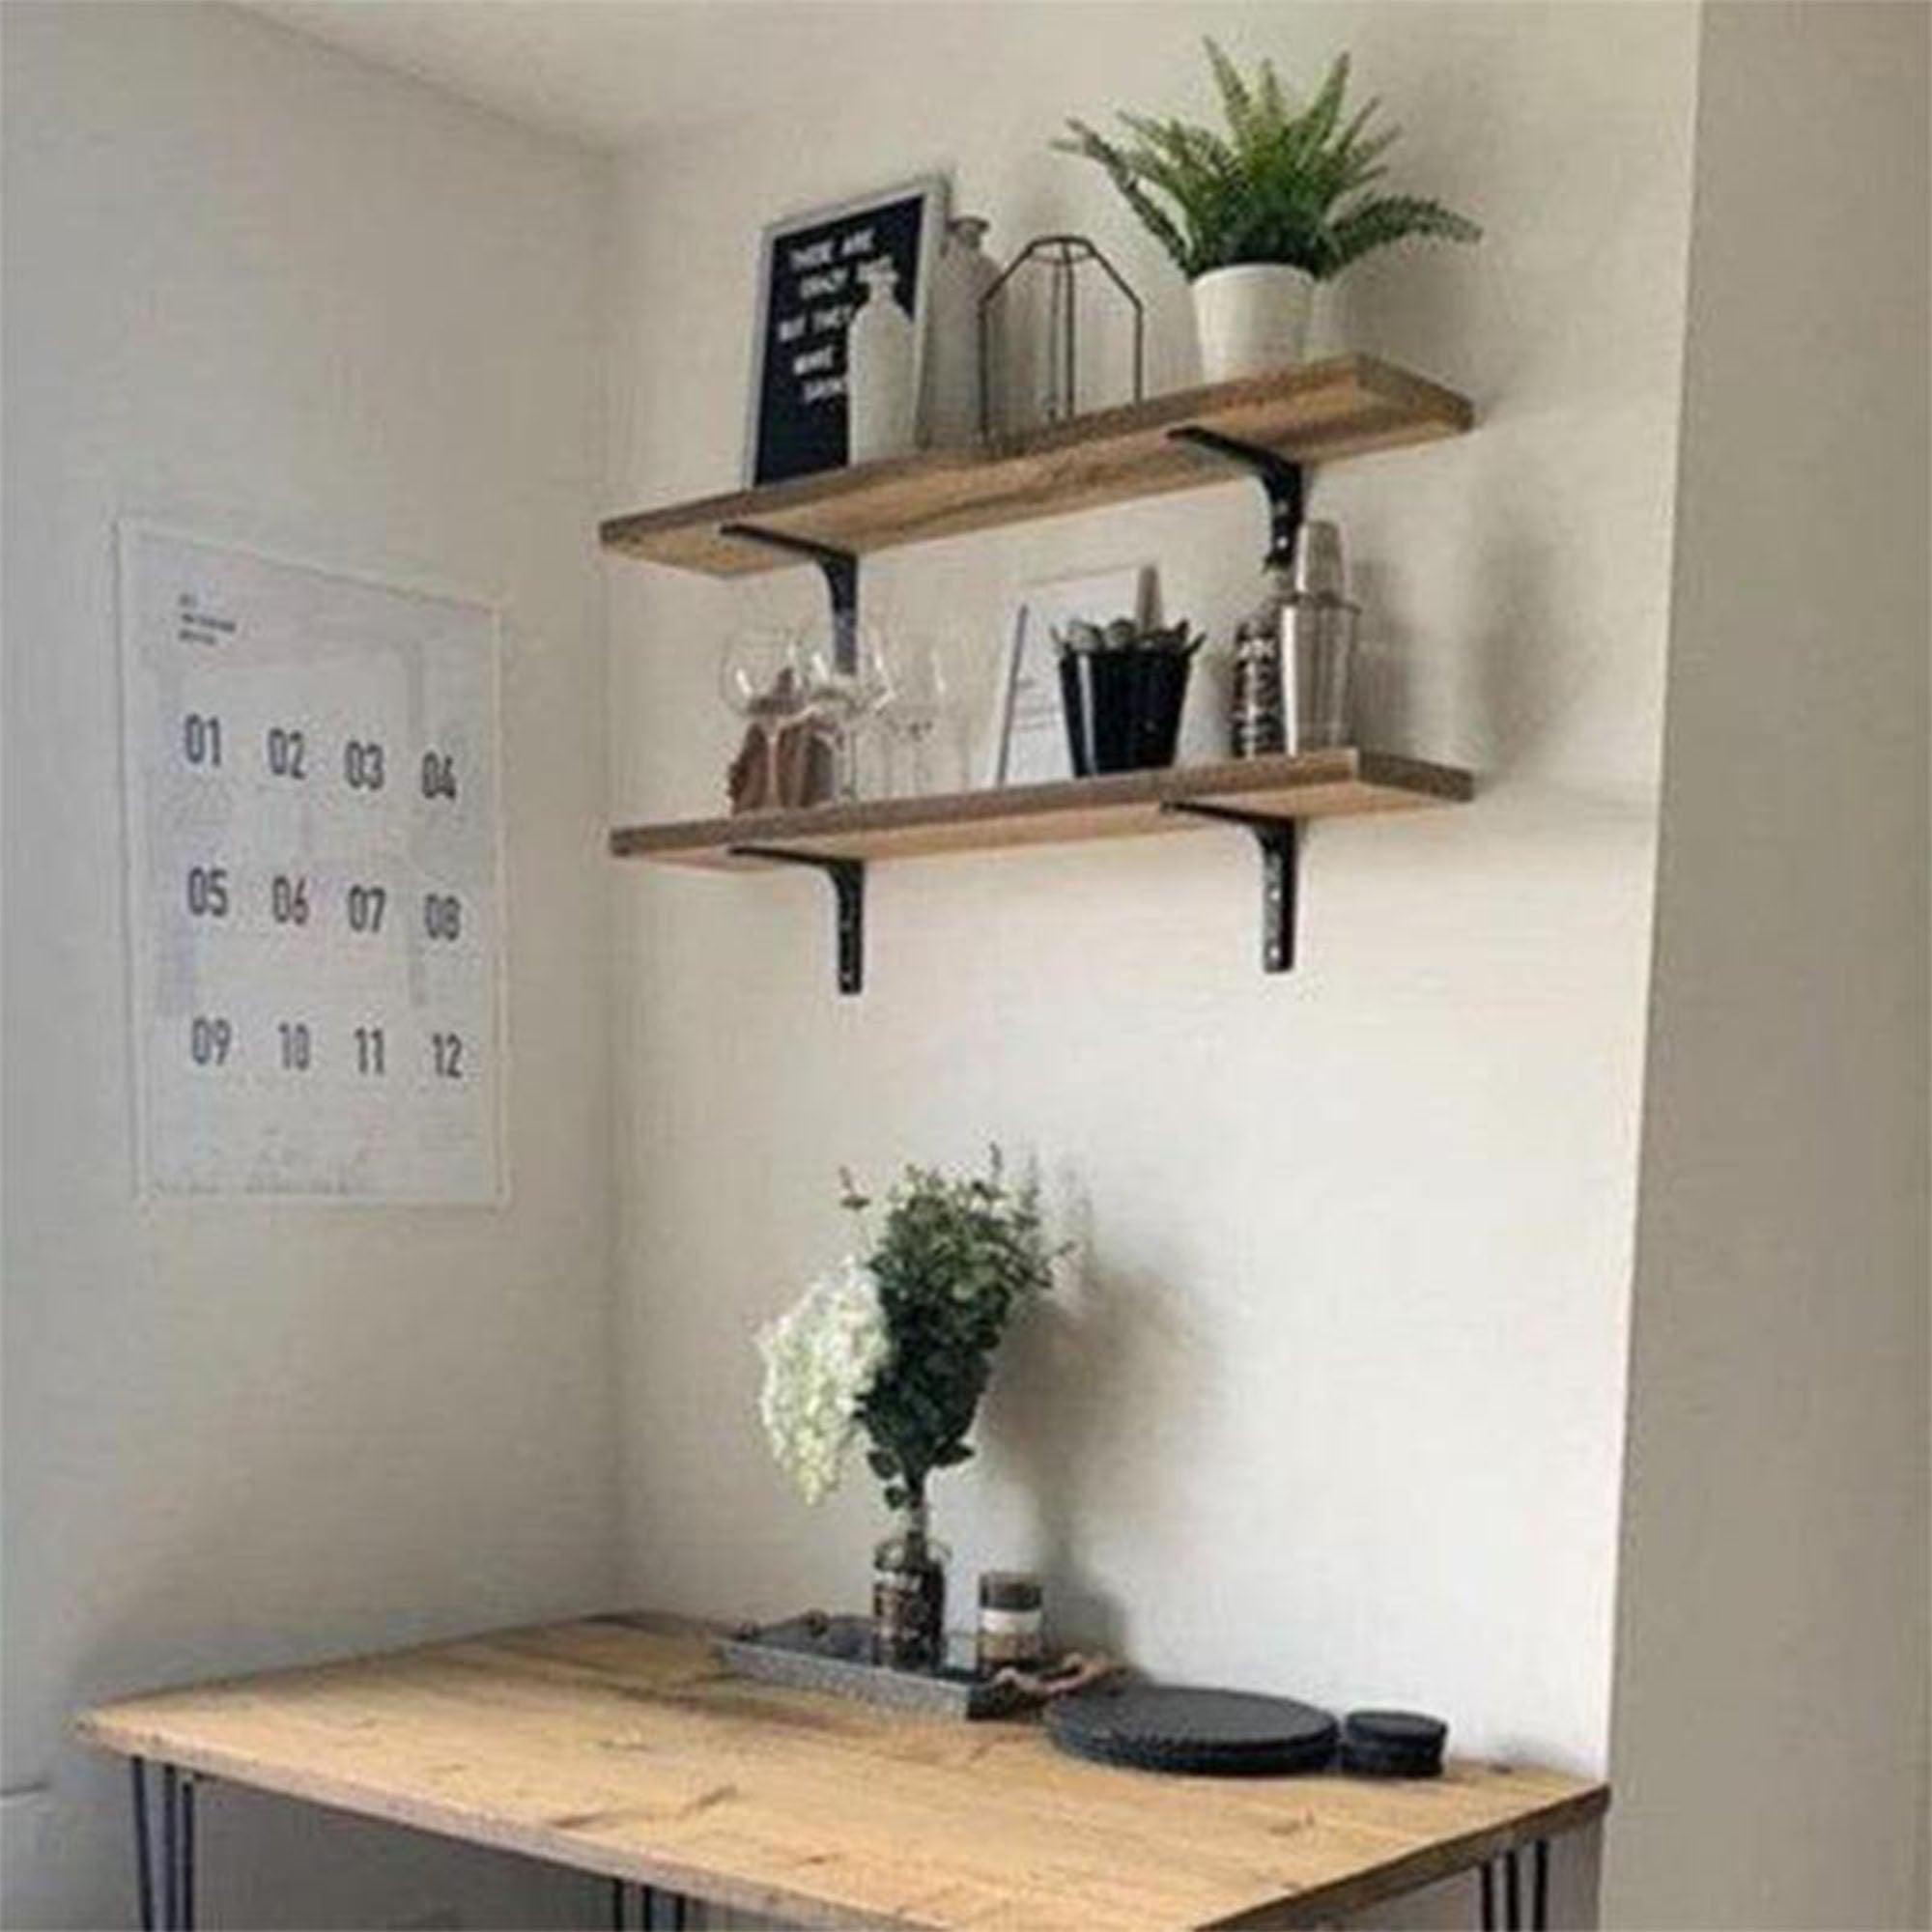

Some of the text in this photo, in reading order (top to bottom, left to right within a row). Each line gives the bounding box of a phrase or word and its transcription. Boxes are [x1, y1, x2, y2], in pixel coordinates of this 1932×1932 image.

[183, 713, 458, 802] 01 02 03 04
[186, 866, 462, 943] 05 06 07 08
[190, 1015, 464, 1080] 09 10 11 12
